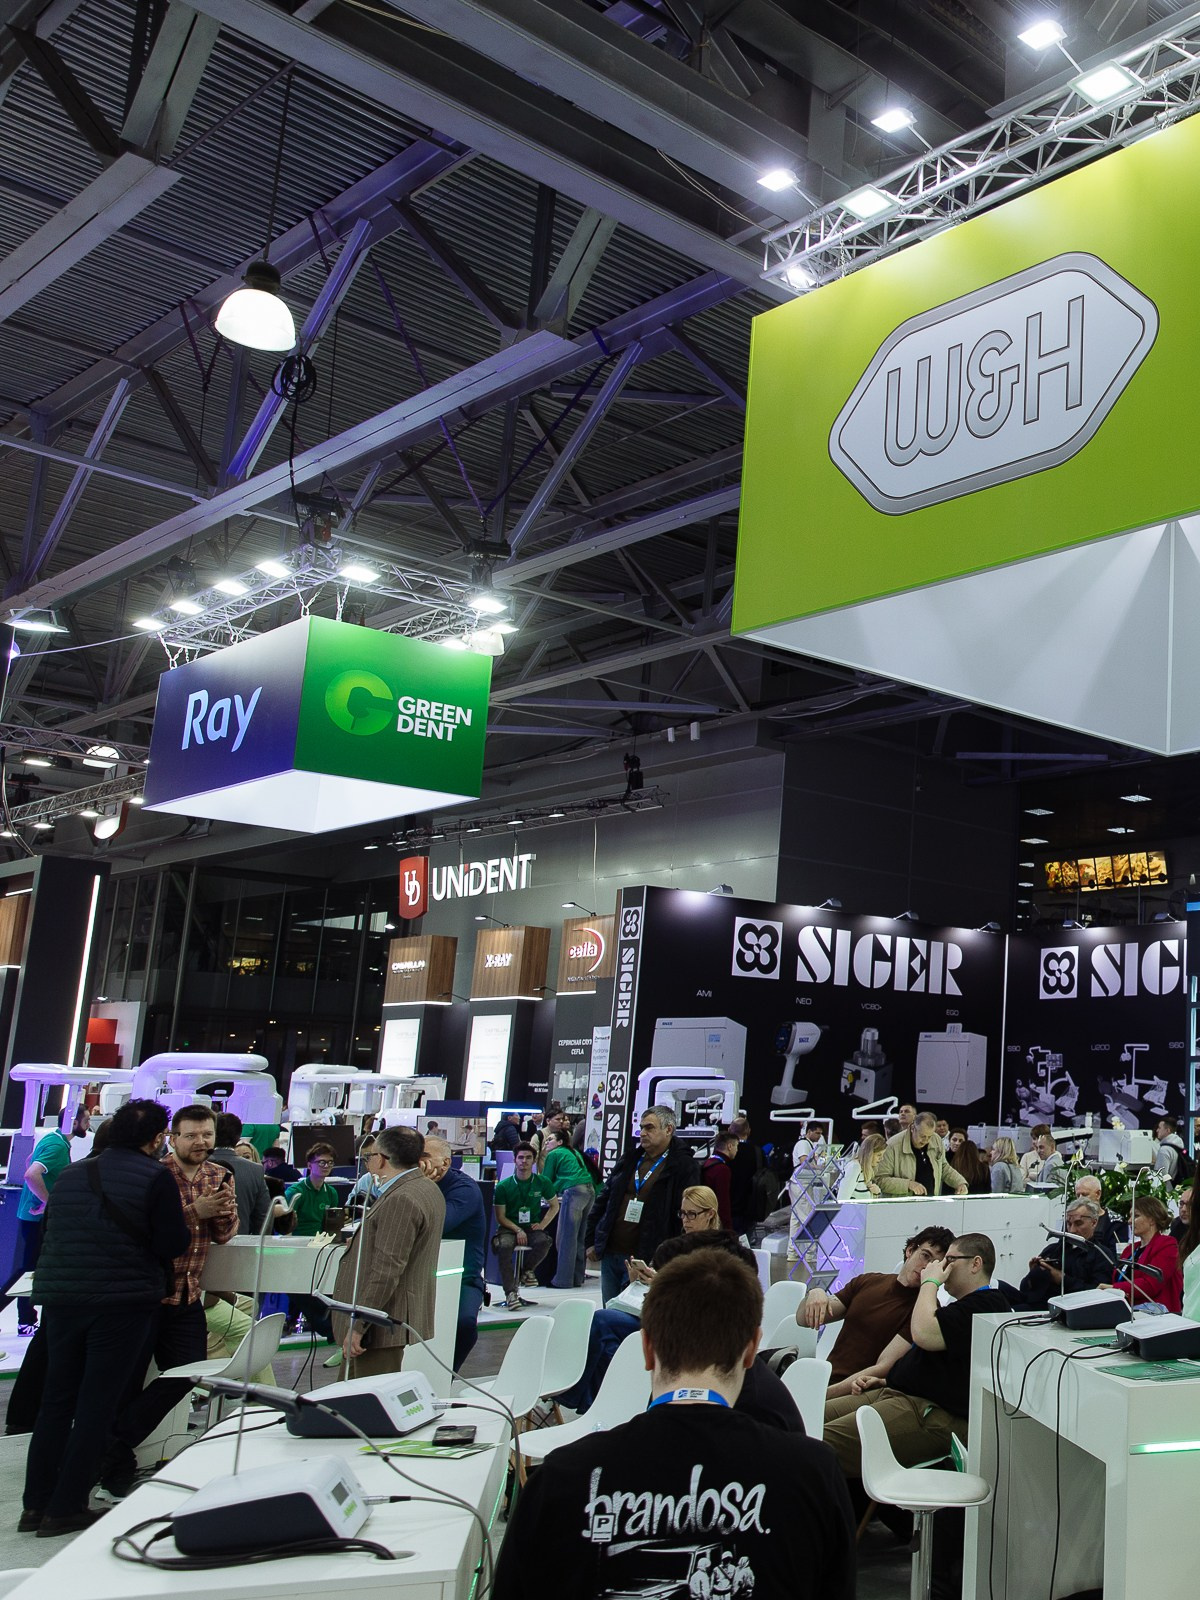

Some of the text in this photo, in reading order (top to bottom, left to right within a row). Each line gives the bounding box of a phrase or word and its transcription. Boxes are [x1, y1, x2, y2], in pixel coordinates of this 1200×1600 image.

[882, 295, 1085, 467] W&H
[181, 686, 262, 752] Ray
[396, 714, 458, 741] DENT
[397, 696, 473, 726] GREEN
[615, 947, 635, 1029] SIGER
[796, 925, 963, 996] SIGER
[795, 997, 812, 1006] NEO
[602, 1113, 621, 1184] SIGE
